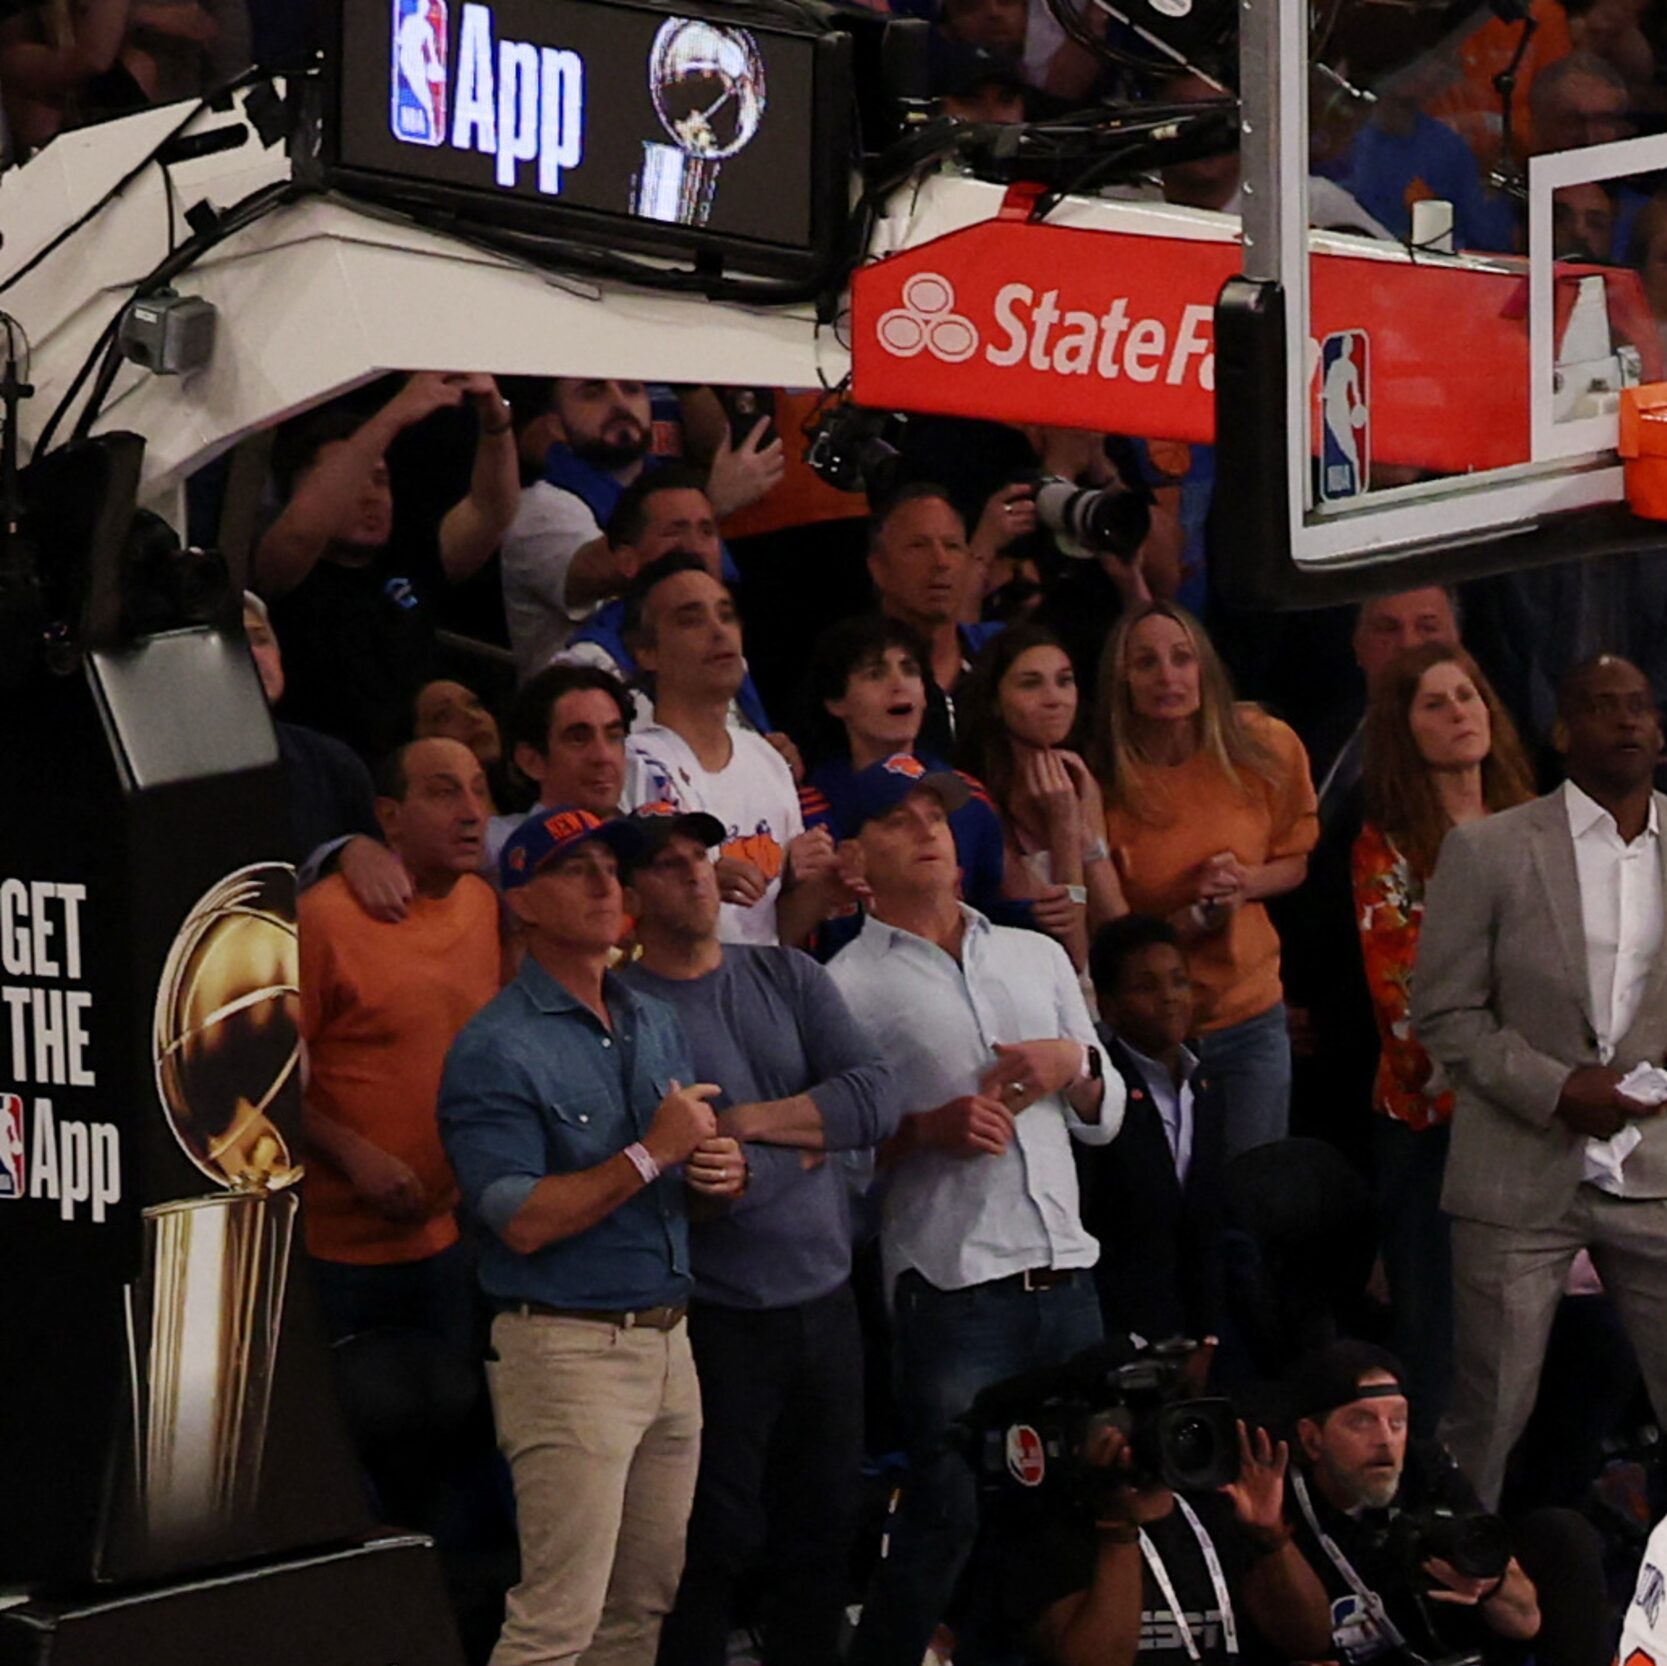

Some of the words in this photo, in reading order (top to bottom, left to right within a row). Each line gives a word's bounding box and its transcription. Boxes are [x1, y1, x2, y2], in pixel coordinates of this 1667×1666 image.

[451, 2, 584, 195] App
[984, 282, 1216, 392] StateF
[0, 877, 88, 980] GET
[1, 985, 97, 1087] THE
[30, 1097, 122, 1224] App
